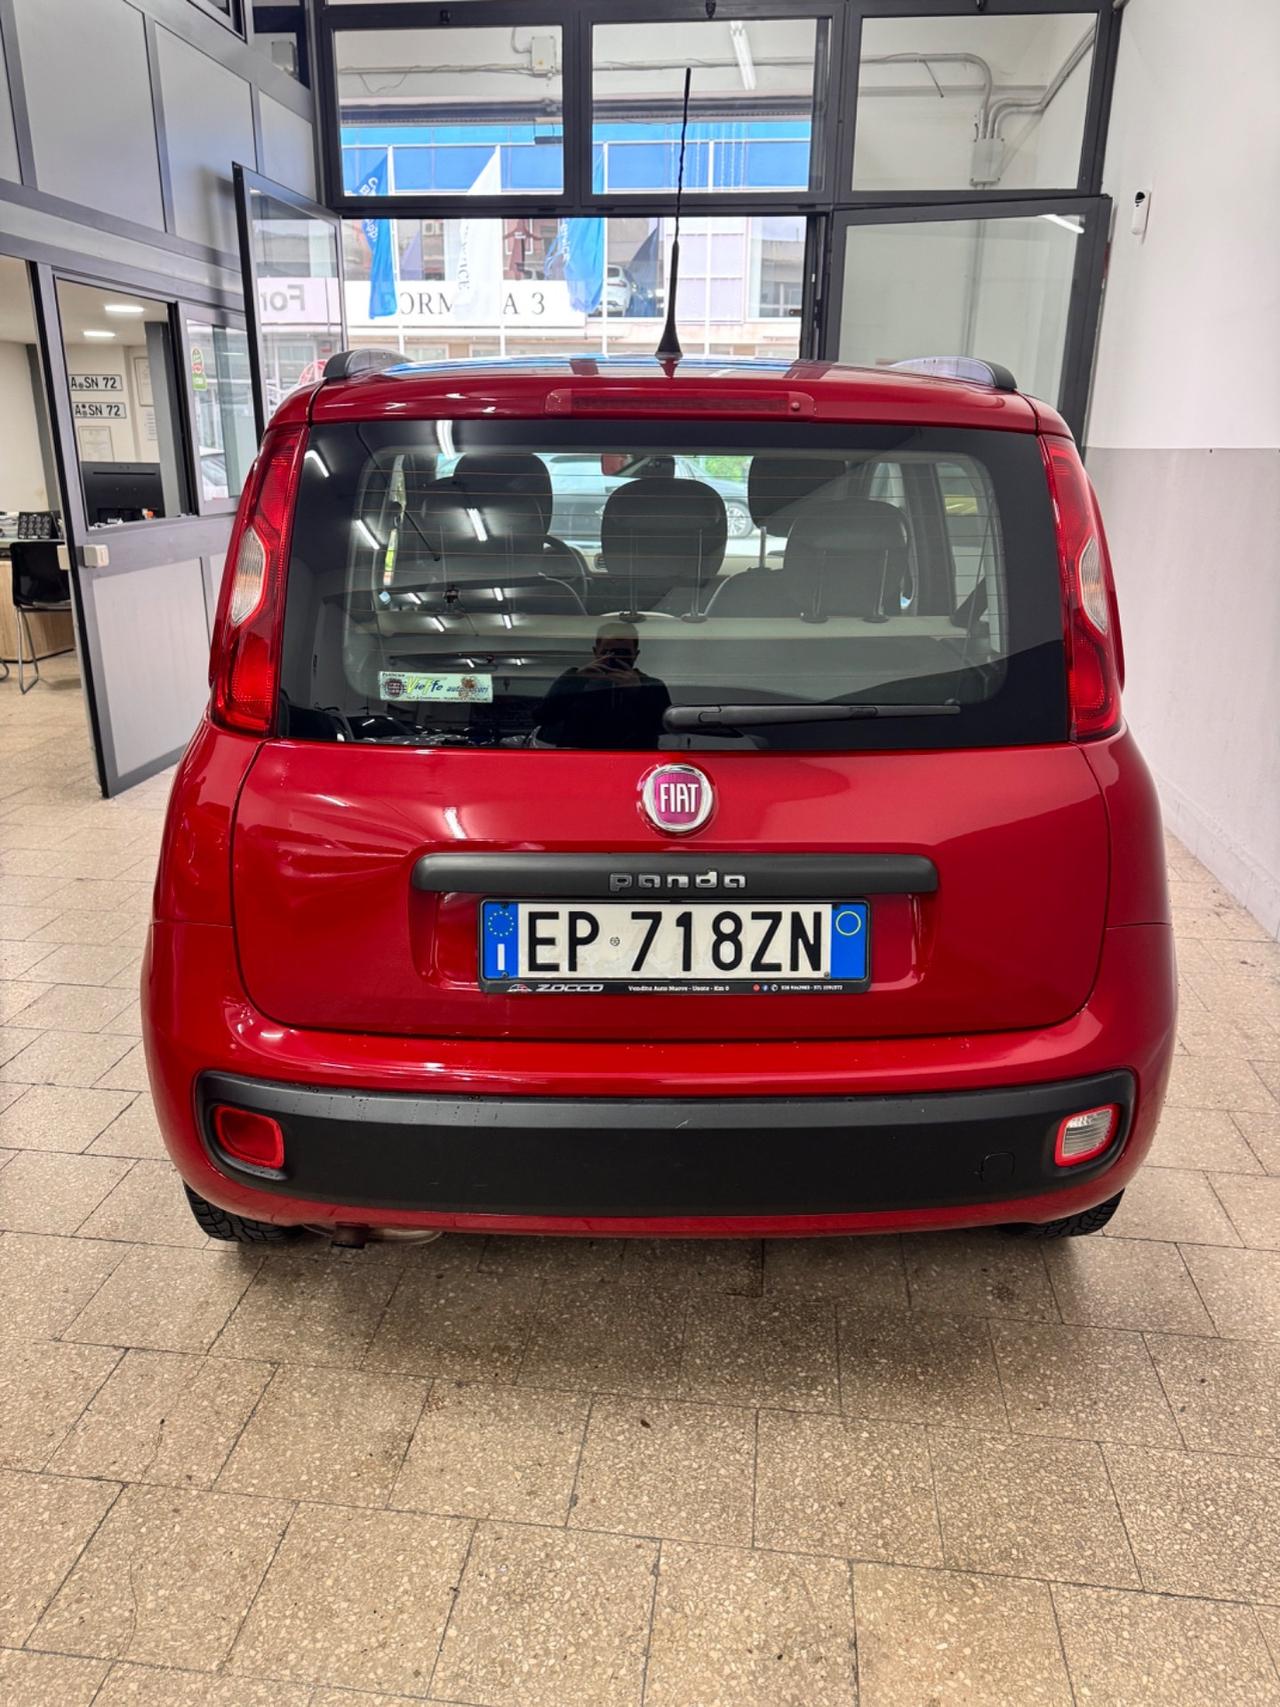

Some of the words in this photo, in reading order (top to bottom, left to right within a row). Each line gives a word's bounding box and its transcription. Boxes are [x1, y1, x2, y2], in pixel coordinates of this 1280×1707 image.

[531, 291, 546, 315] 3
[659, 782, 700, 813] FIAT
[608, 870, 748, 892] panda
[527, 911, 600, 973] EP
[630, 911, 823, 973] 718ZN
[535, 983, 605, 992] ZOCCO
